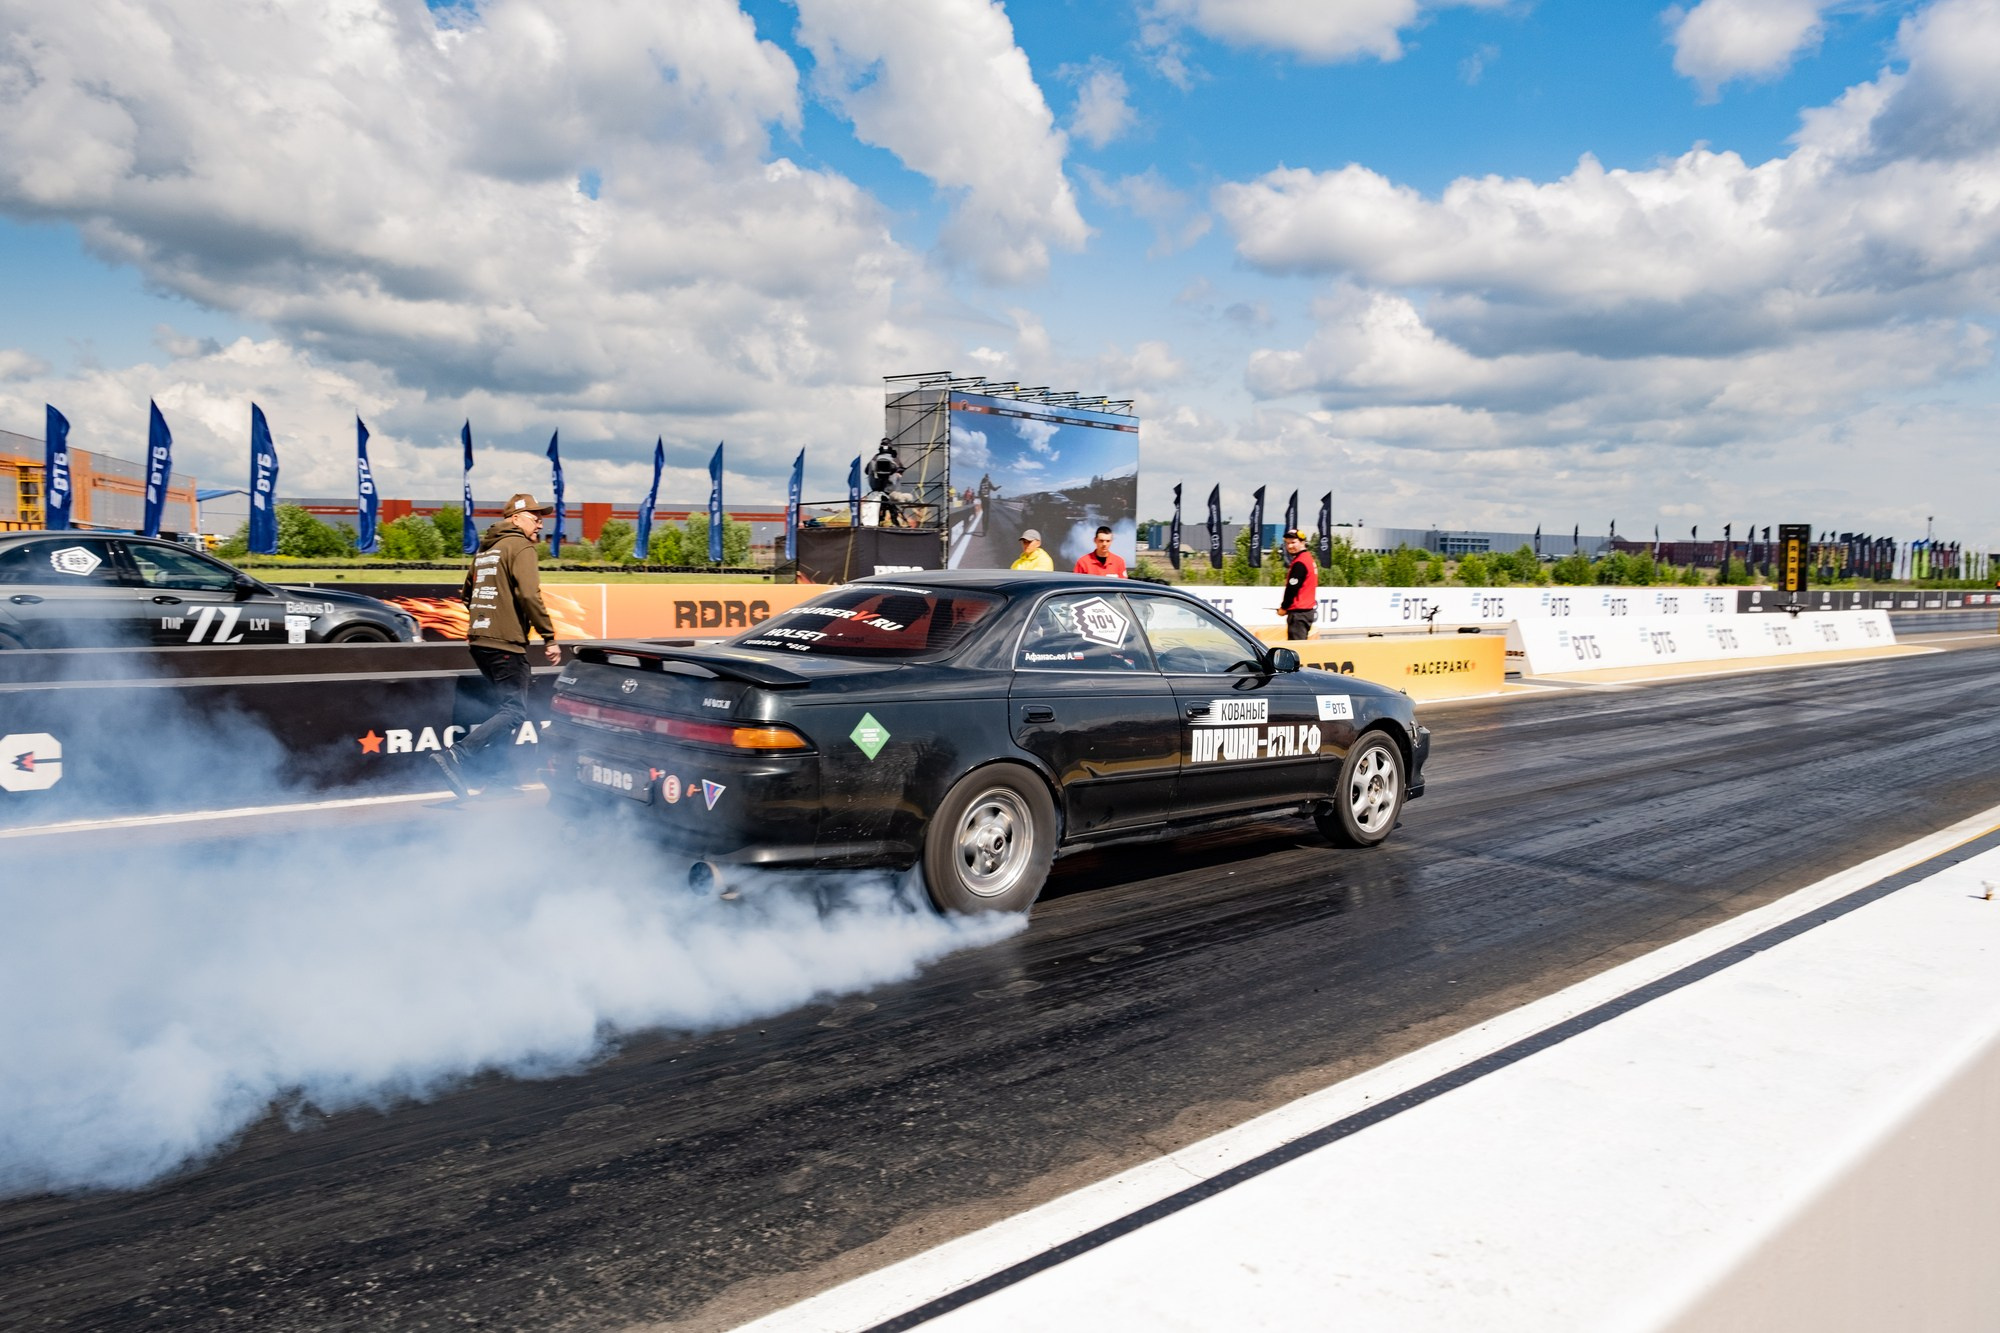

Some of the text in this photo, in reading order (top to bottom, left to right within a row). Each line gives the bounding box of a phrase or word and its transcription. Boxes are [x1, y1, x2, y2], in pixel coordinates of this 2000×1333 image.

[53, 452, 69, 491] ВТБ
[151, 446, 169, 485] ВТБ
[256, 453, 272, 493] ВТБ
[673, 600, 770, 628] RDRC
[1403, 598, 1429, 620] ВТБ
[1482, 598, 1504, 618] ВТБ
[1551, 598, 1571, 617] ВТБ
[1610, 598, 1629, 616] ВТБ
[1662, 597, 1679, 615] ВТБ
[1710, 597, 1725, 613] ВТБ
[1087, 615, 1116, 629] 404
[763, 628, 828, 643] HOLSET
[1650, 631, 1677, 655] ВТБ
[1716, 628, 1739, 651] ВТБ
[1571, 635, 1601, 661] ВТБ
[1412, 660, 1471, 676] RACEPARK
[1221, 702, 1266, 721] КОВАНЫЕ
[1332, 703, 1347, 715] ВТБ
